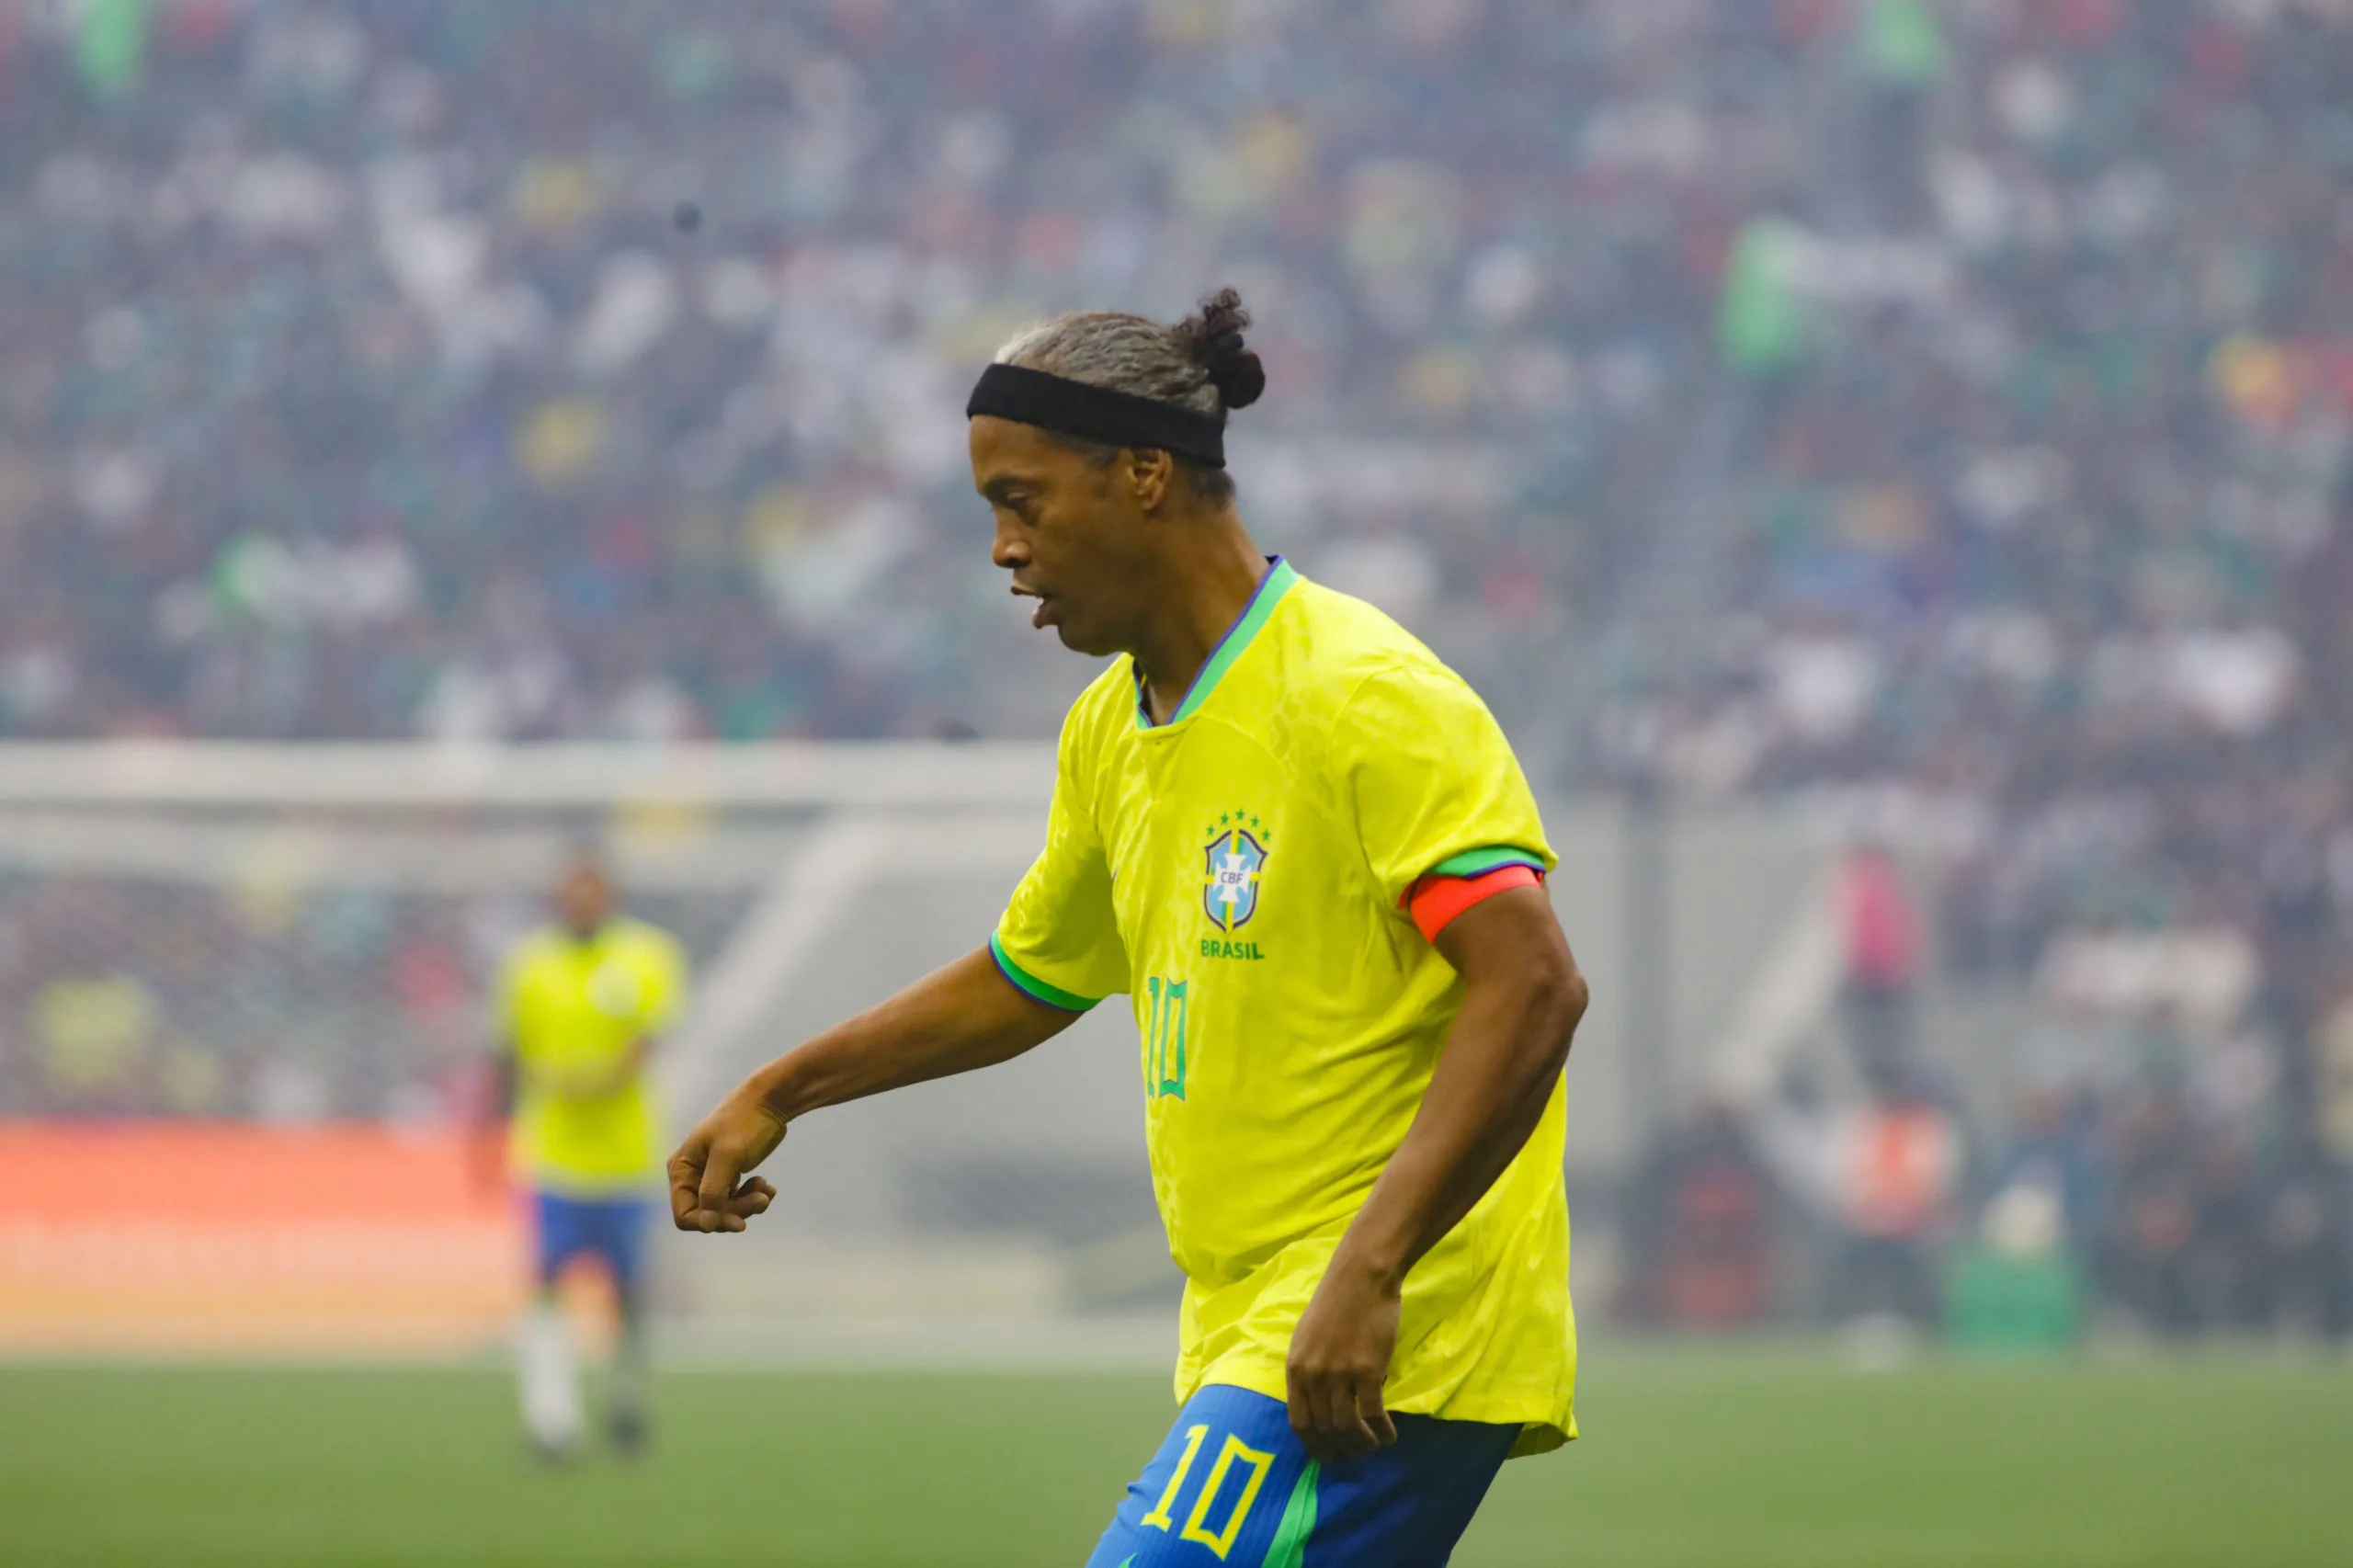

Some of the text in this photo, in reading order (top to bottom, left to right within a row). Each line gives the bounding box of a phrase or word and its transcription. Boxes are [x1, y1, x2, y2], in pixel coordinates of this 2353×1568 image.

[1220, 871, 1244, 885] CBF
[1200, 939, 1266, 960] BRASIL
[1148, 976, 1188, 1101] 10
[1140, 1424, 1276, 1562] 10
